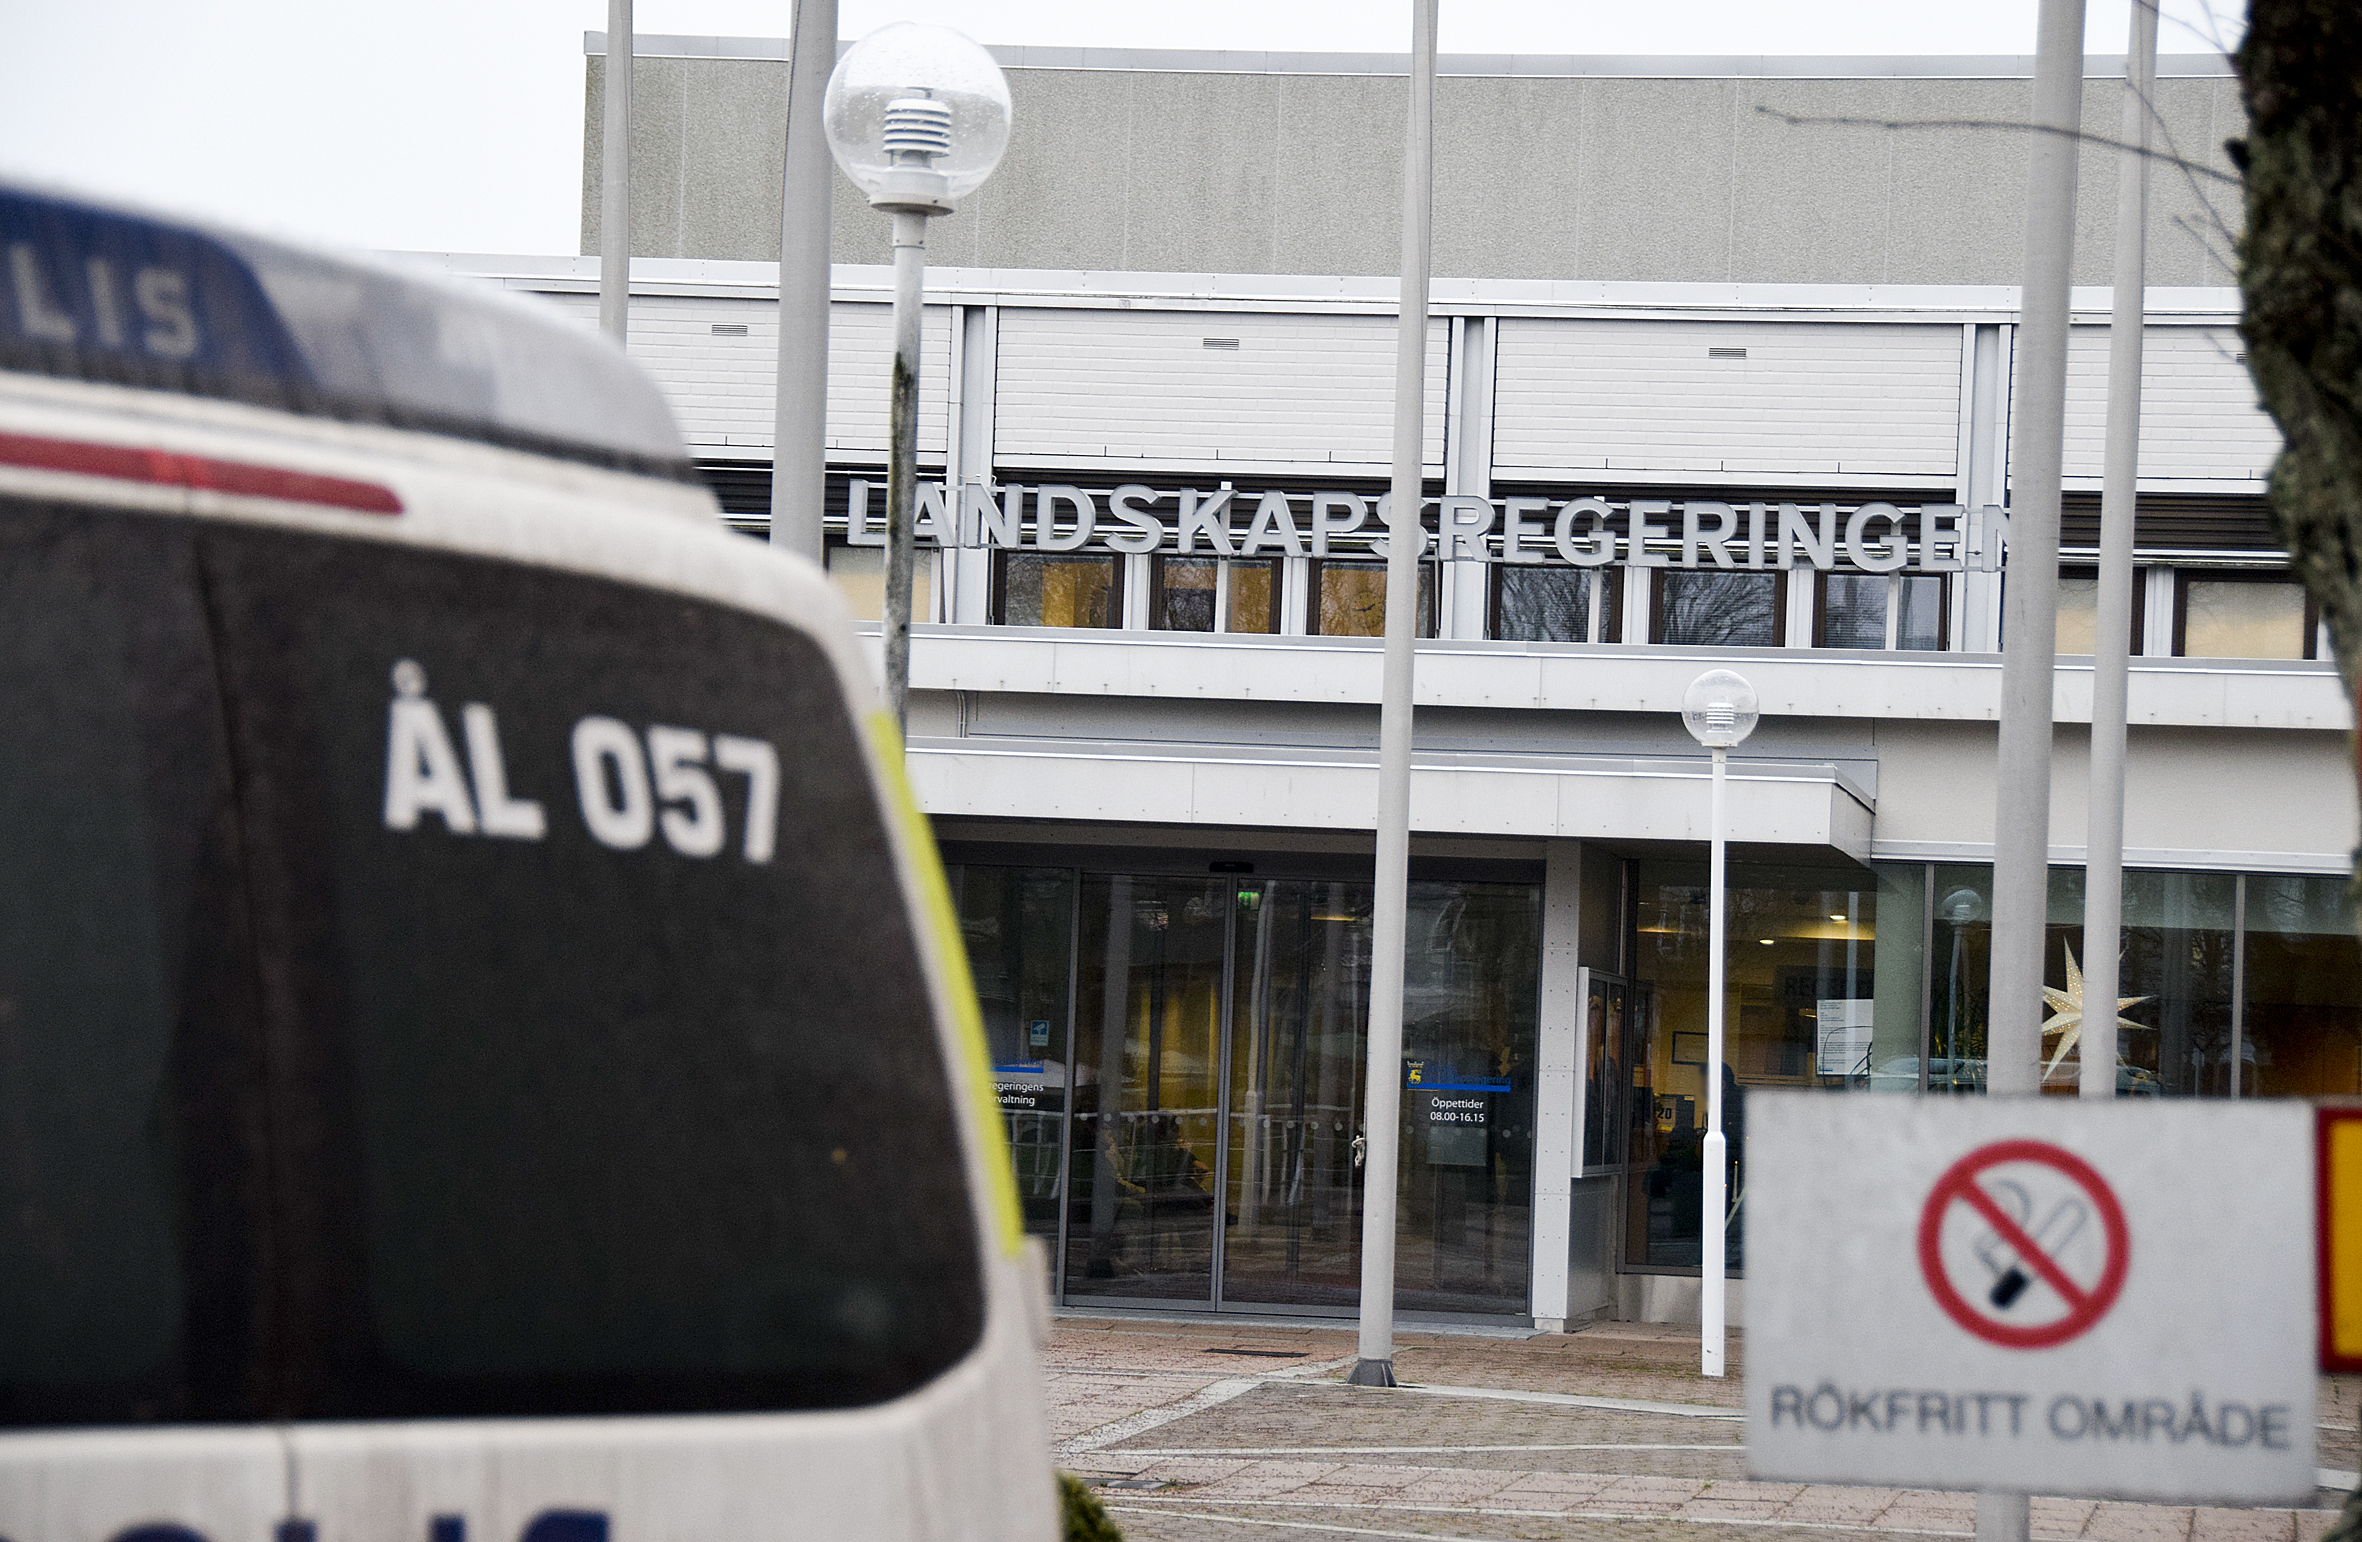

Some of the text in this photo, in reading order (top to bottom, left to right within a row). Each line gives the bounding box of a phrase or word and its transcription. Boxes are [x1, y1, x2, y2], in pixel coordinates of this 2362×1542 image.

[385, 658, 781, 865] ÅL 057
[1429, 1111, 1485, 1123] 08.00-16.15
[1431, 1096, 1484, 1109] Öppettider
[1771, 1382, 2293, 1451] RÖKFRITT OMRÅDE
